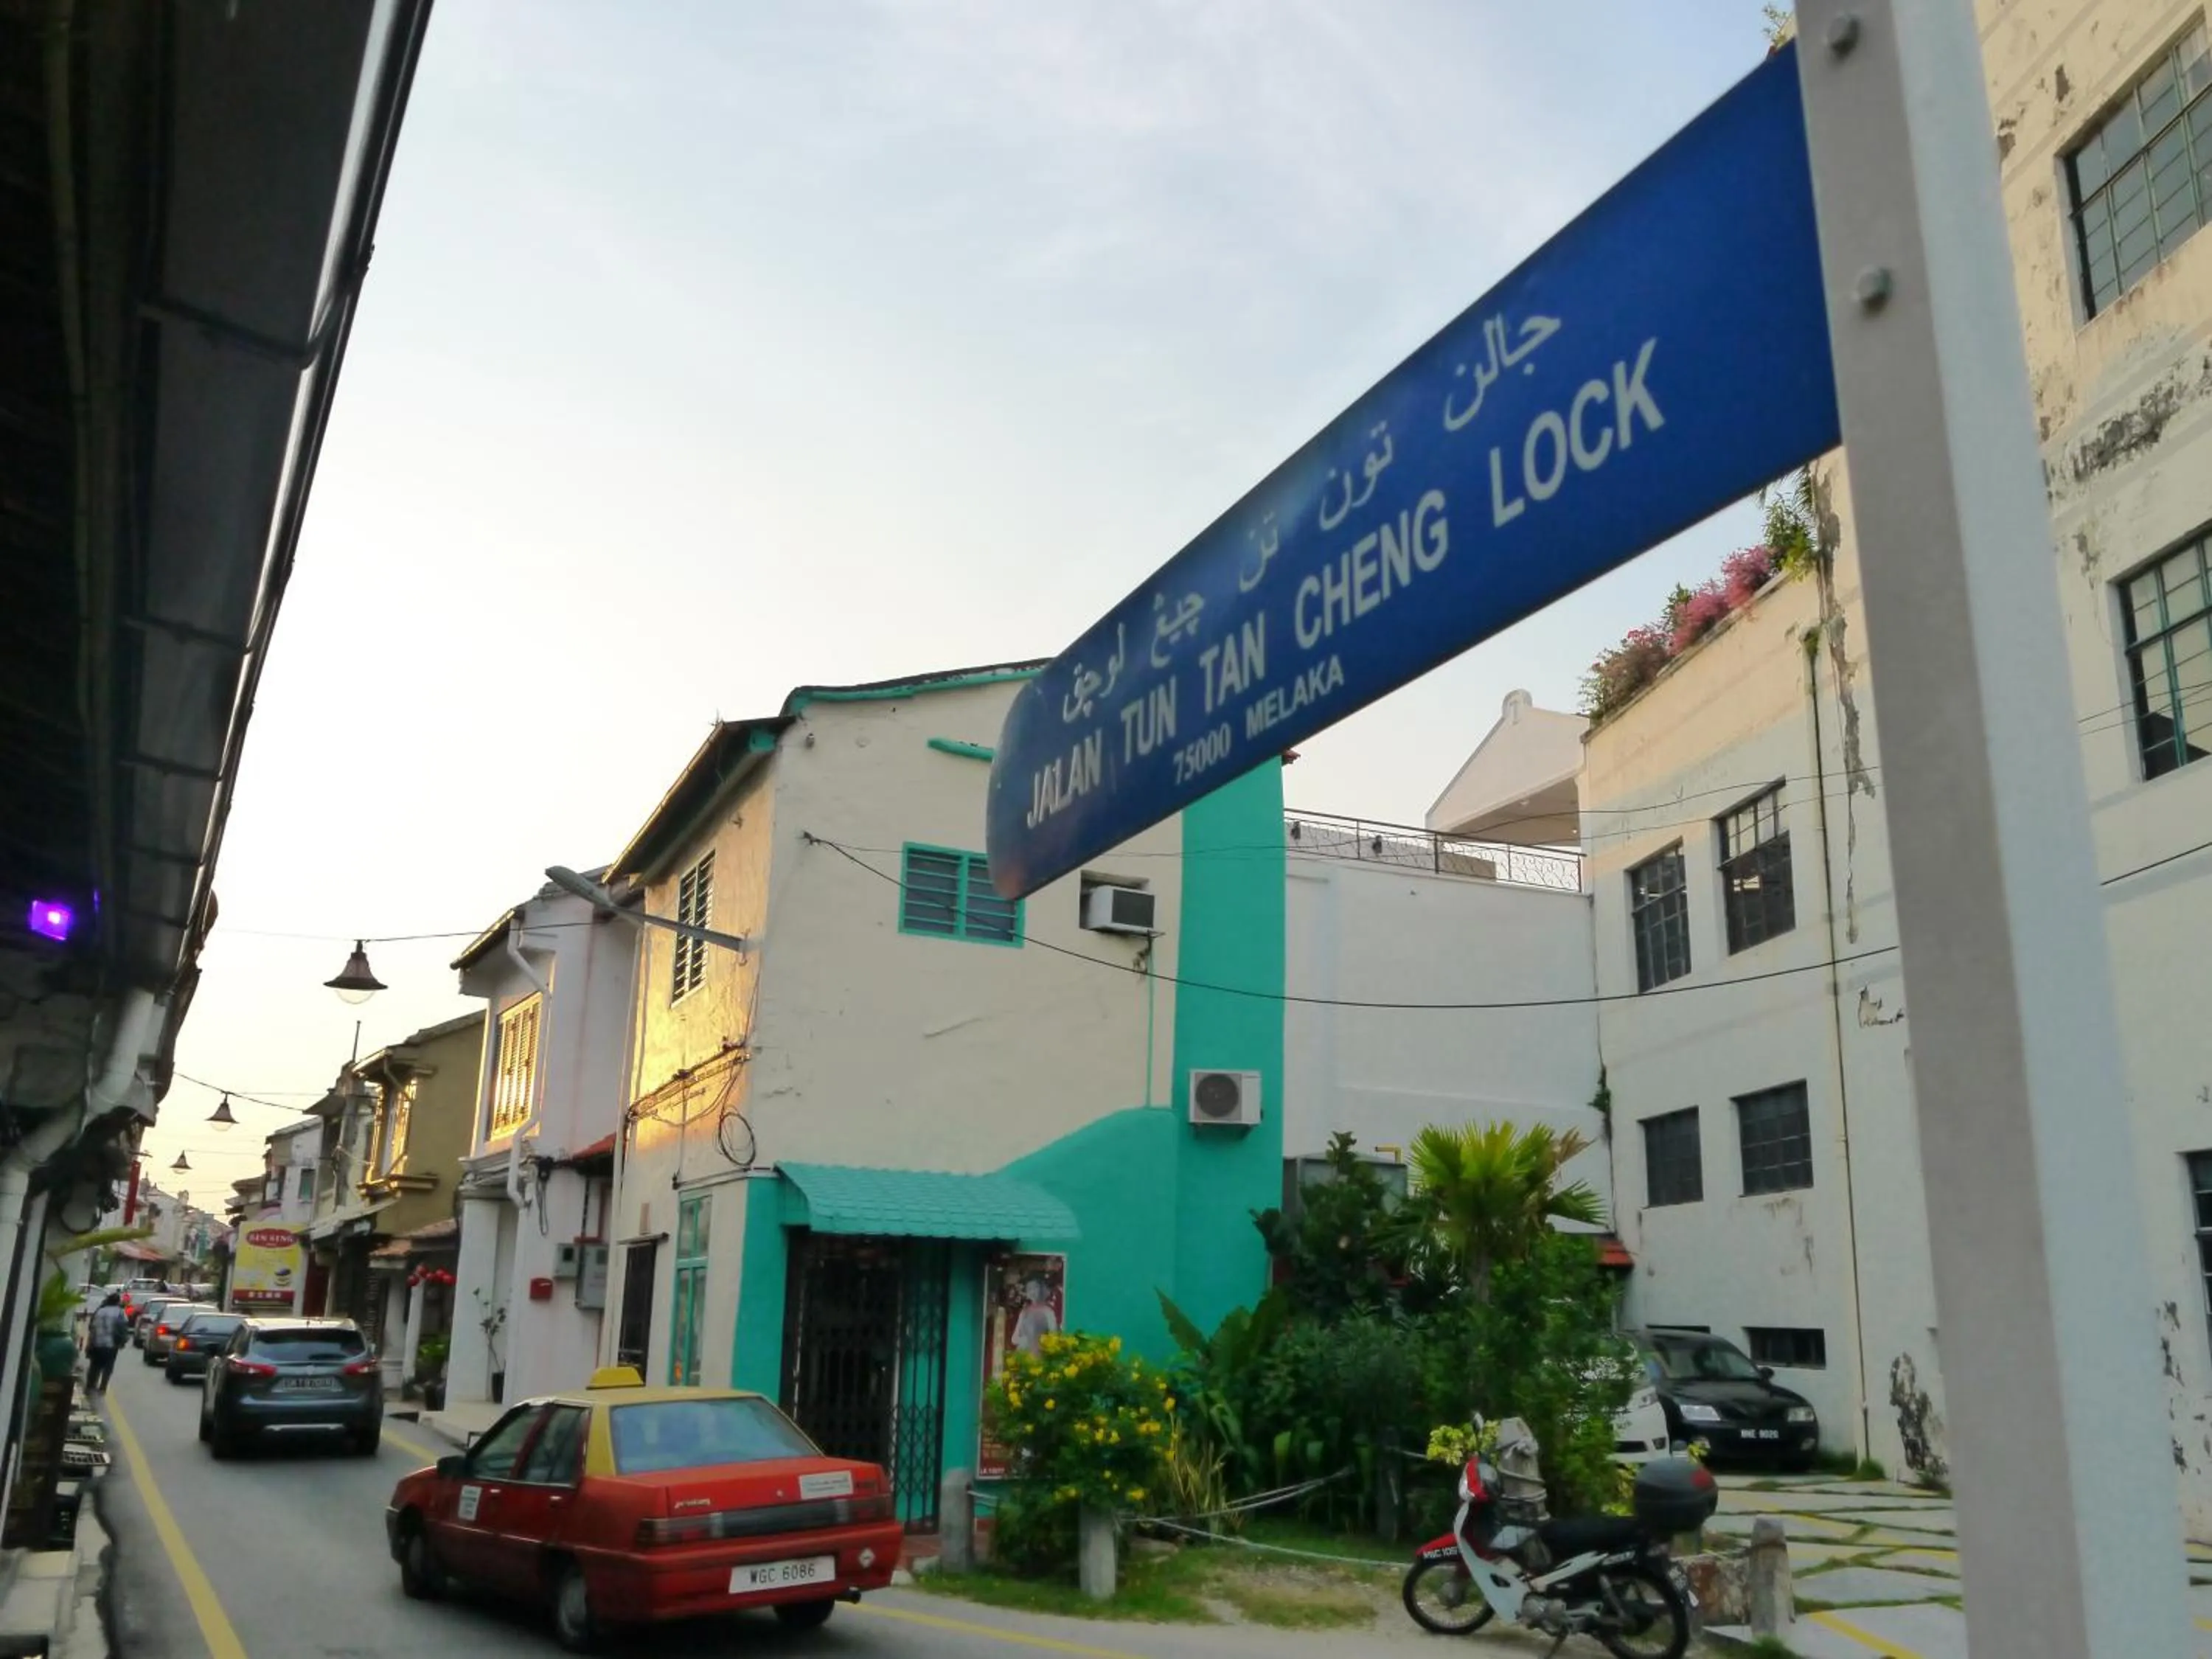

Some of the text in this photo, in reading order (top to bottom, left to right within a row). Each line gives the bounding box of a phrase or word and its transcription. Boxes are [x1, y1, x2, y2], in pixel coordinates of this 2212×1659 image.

[1443, 313, 1561, 431] جالن
[1318, 420, 1394, 532] تون
[1026, 336, 1666, 830] JALAN TUN TAN CHENG LOCK
[1173, 654, 1345, 785] 75000 MELAKA
[750, 1563, 815, 1585] WGC 6086
